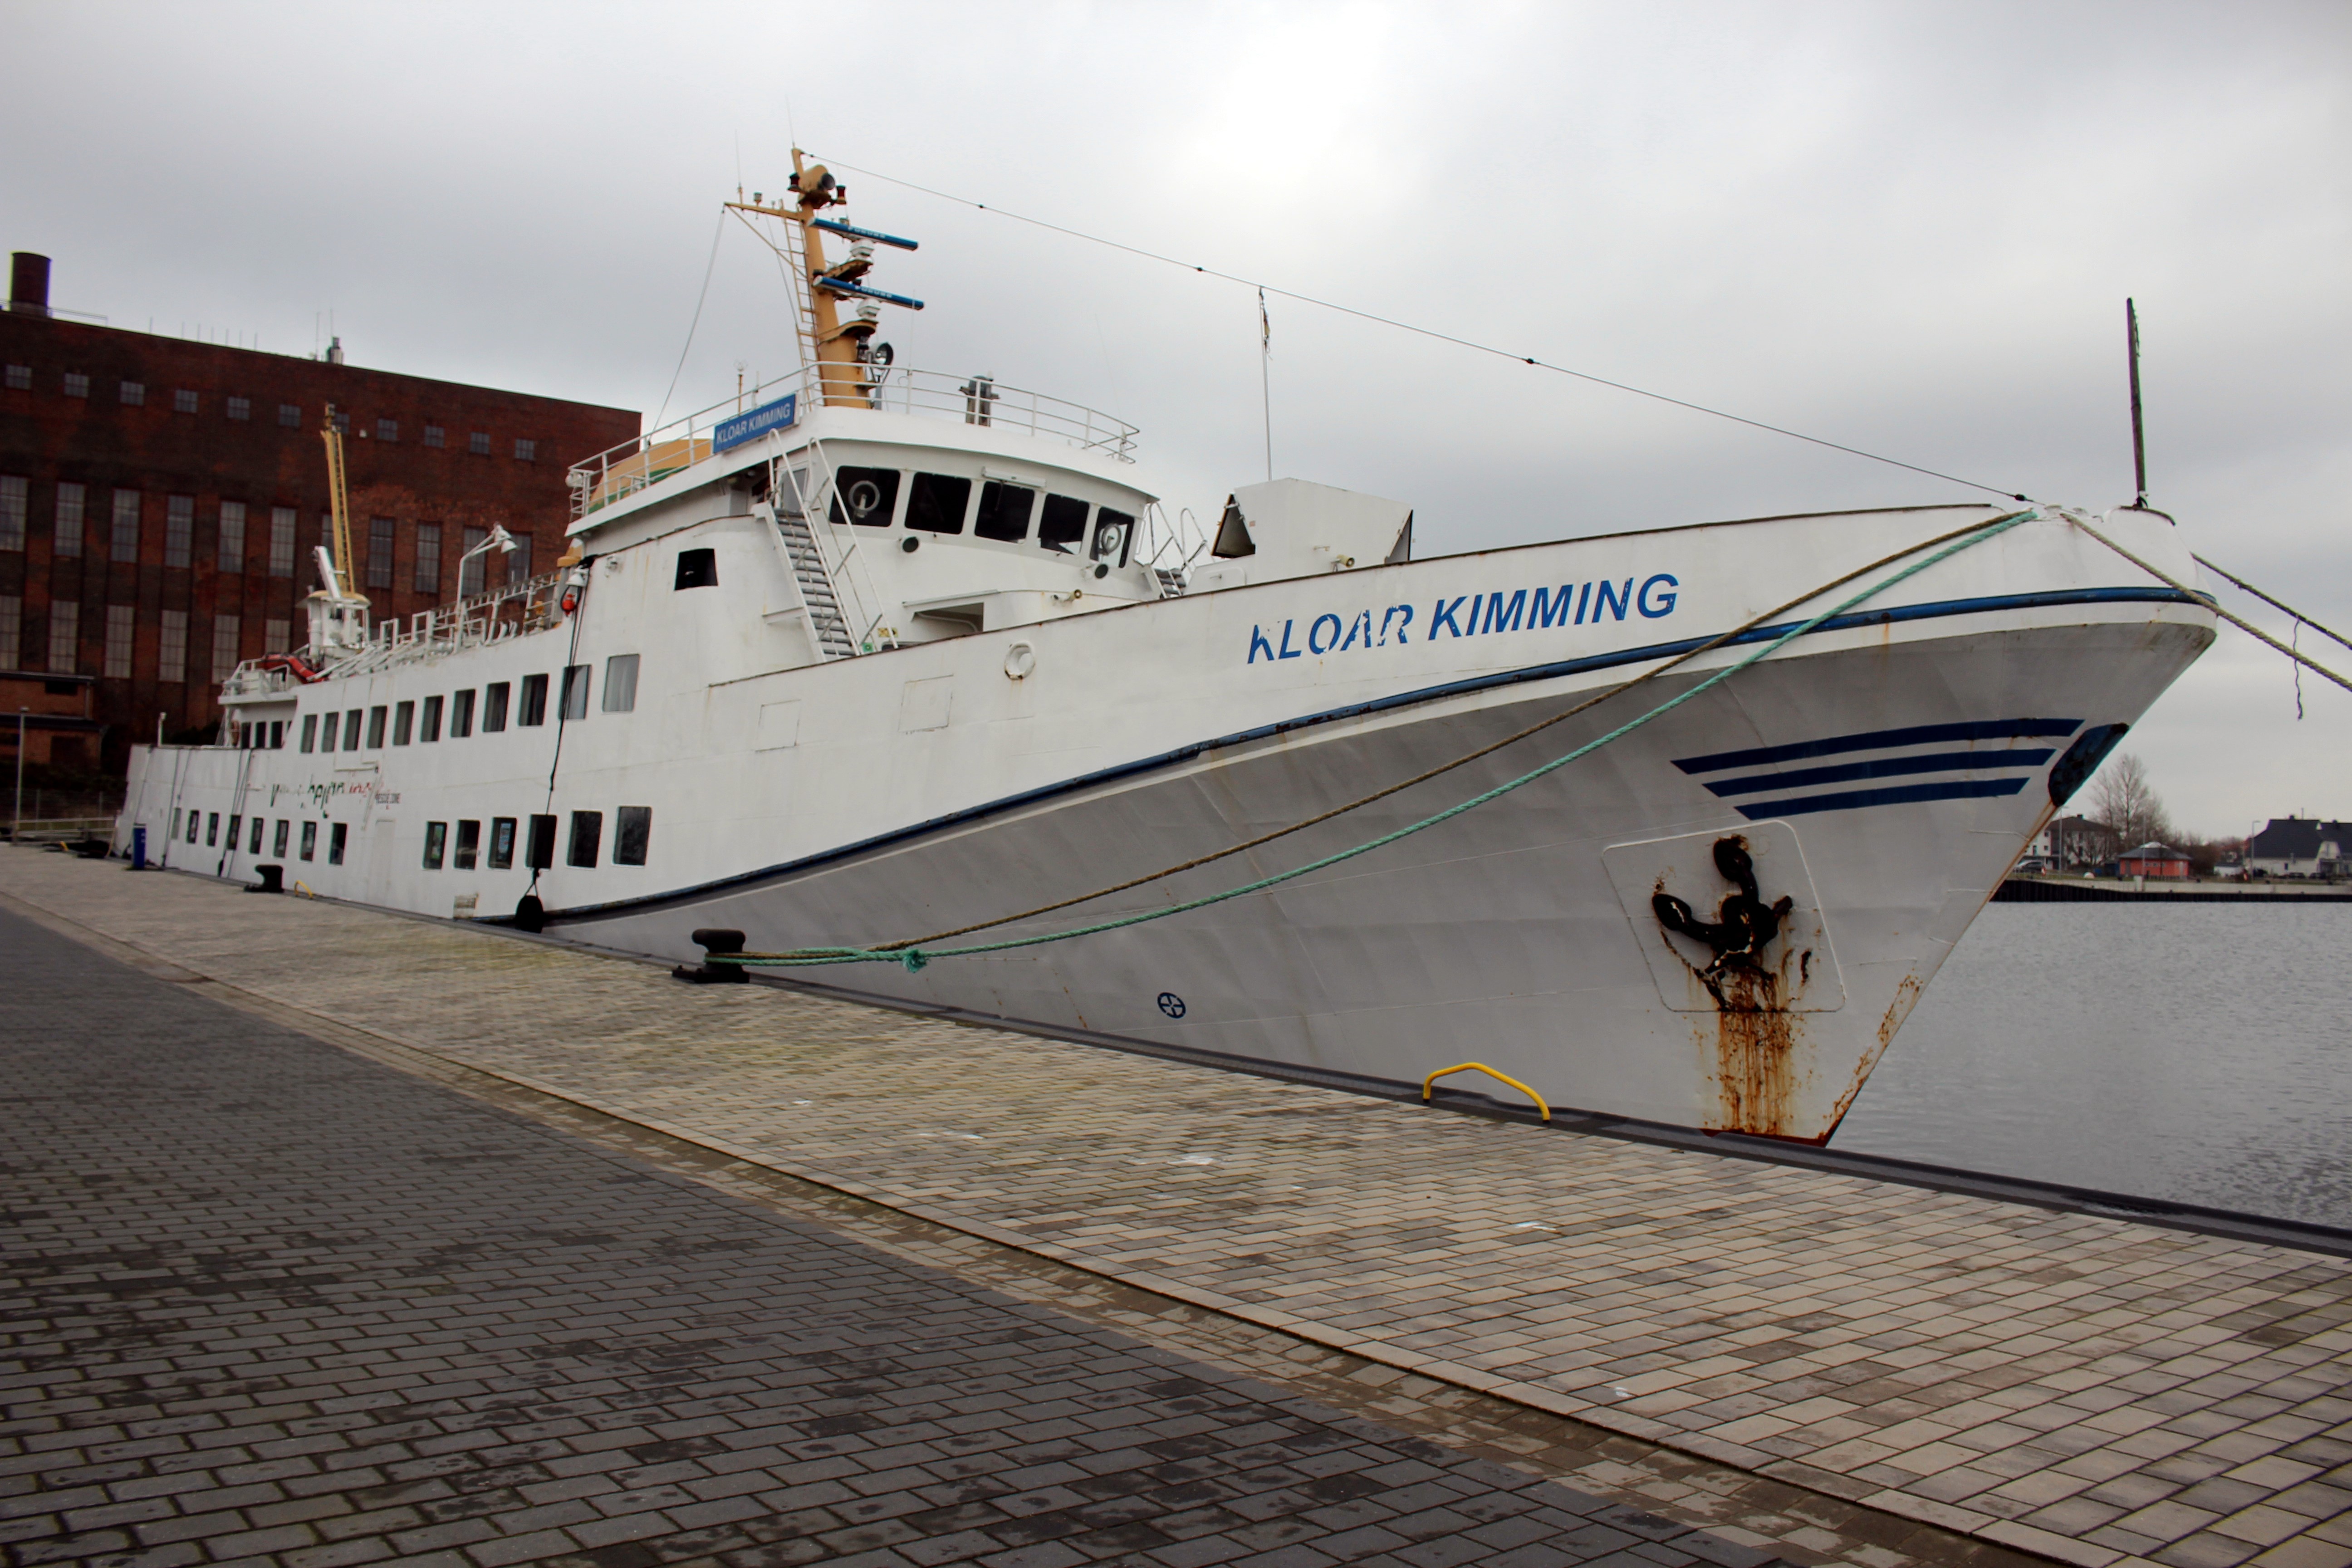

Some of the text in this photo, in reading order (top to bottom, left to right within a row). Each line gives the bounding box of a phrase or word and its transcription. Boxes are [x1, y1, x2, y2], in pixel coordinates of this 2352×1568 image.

[716, 402, 790, 444] KLOAR KIMMING
[1248, 573, 1680, 664] KLOAR KIMMING
